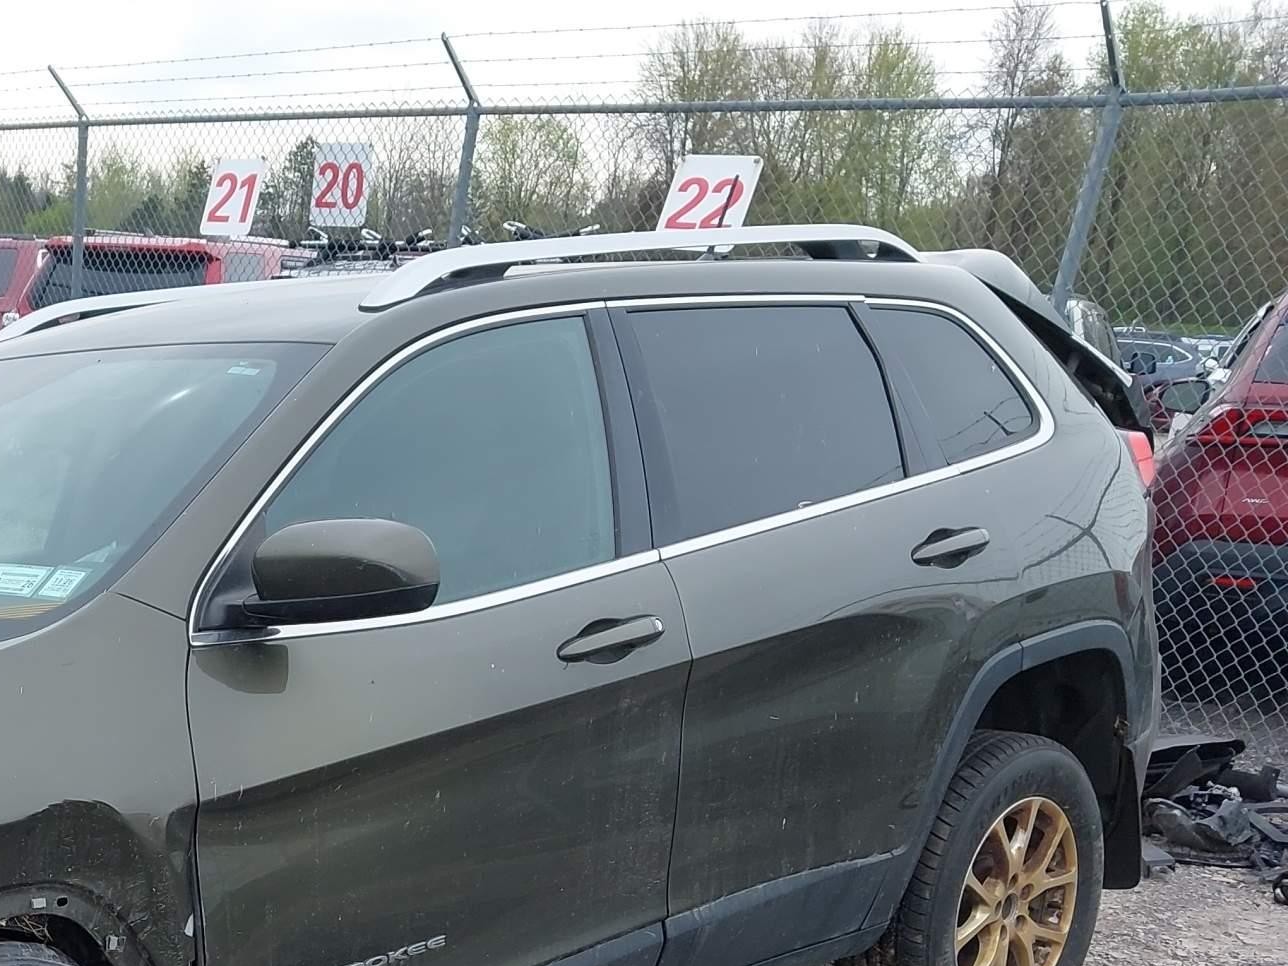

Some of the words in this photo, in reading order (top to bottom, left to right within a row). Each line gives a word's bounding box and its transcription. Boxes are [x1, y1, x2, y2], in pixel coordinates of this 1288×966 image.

[207, 172, 258, 224] 21
[314, 161, 365, 210] 20
[664, 177, 744, 229] 22
